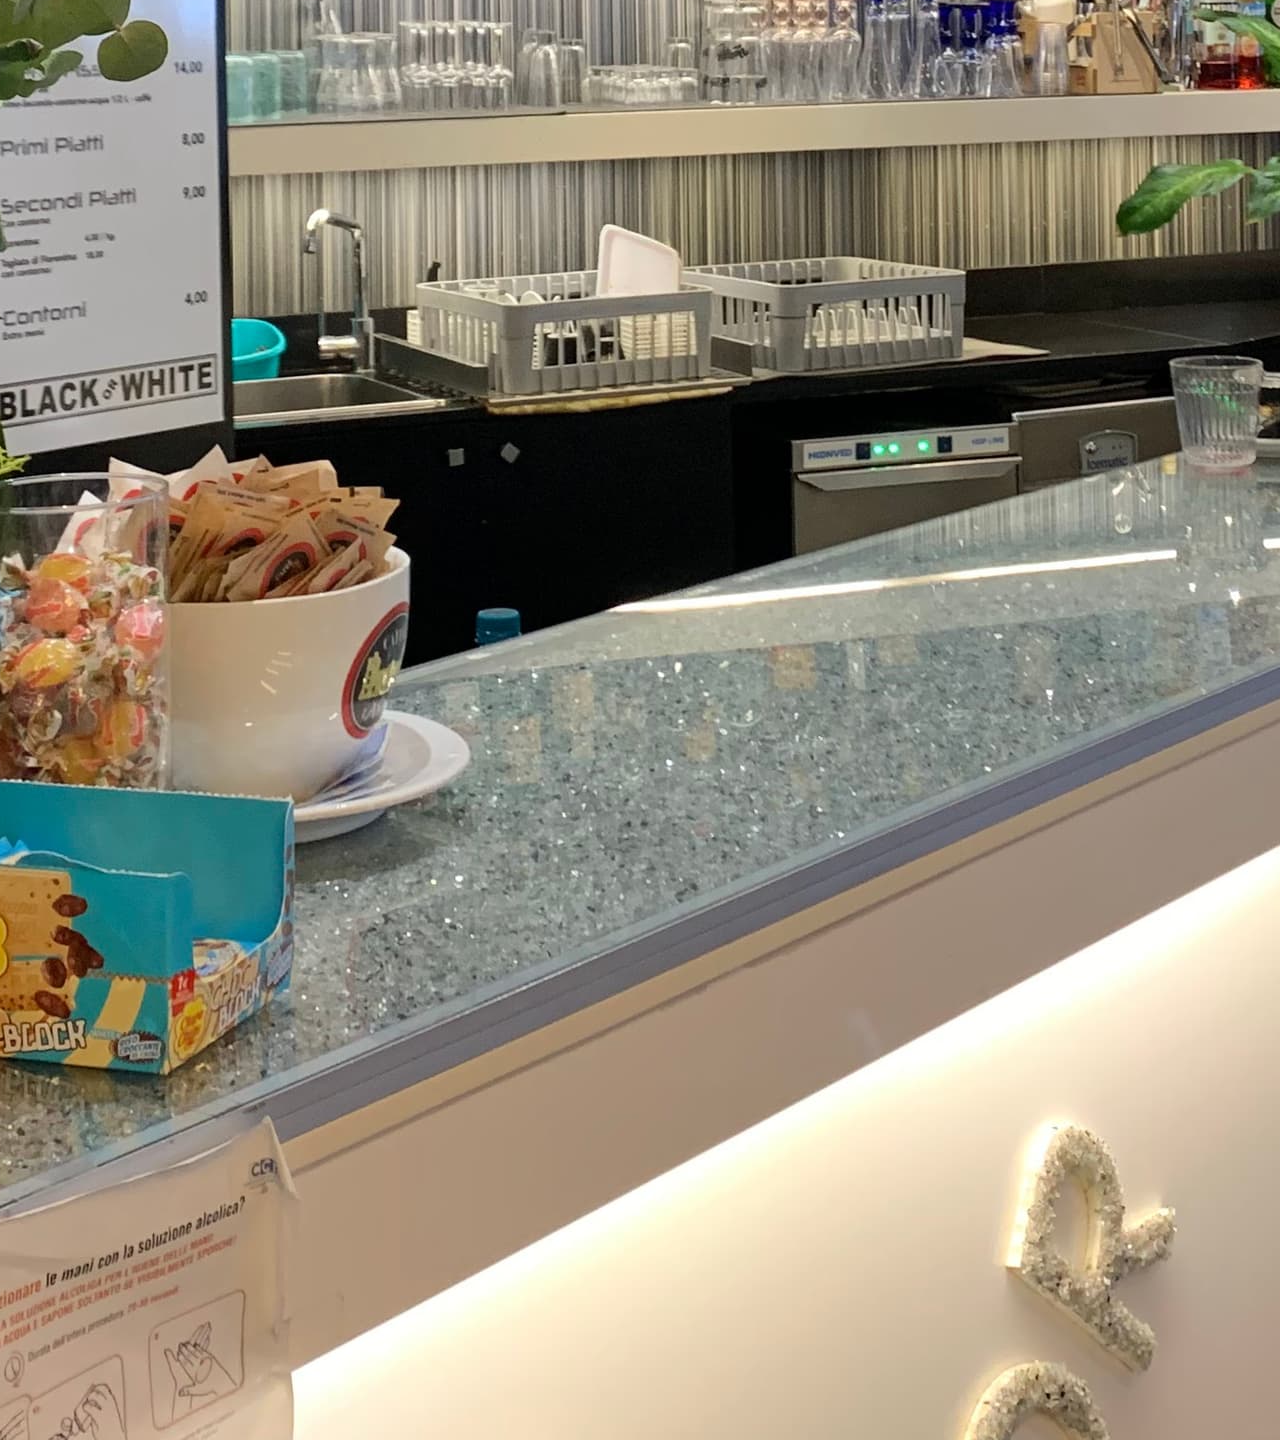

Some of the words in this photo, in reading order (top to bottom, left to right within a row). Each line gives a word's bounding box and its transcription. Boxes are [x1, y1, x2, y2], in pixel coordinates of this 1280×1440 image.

[174, 61, 203, 75] 14,00
[0, 137, 49, 158] Primi
[54, 134, 105, 154] Piatti
[181, 132, 206, 147] 8,00
[0, 191, 84, 216] Secondi
[88, 187, 138, 208] Piatti
[181, 186, 207, 200] 9,00
[3, 302, 88, 327] Contorni
[183, 290, 209, 305] 4,00
[119, 360, 214, 403] WHITE
[1, 1020, 88, 1054] BLOCK
[46, 1272, 58, 1289] le
[60, 1257, 95, 1282] mani
[97, 1251, 120, 1270] con
[123, 1243, 135, 1260] la
[138, 1221, 193, 1255] soluzione
[195, 1195, 247, 1231] alcolica?
